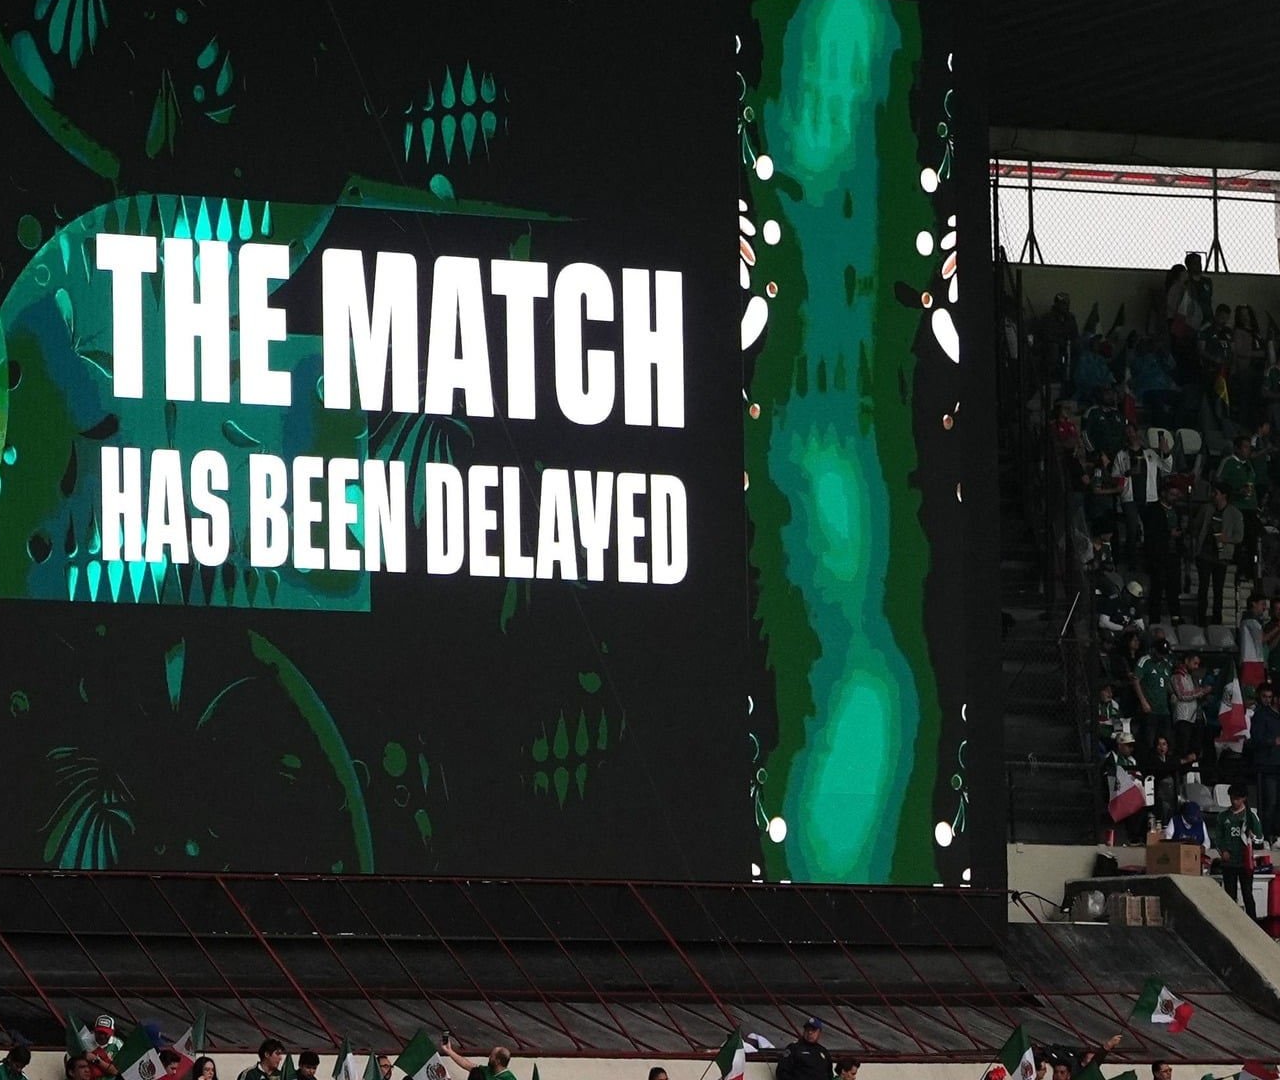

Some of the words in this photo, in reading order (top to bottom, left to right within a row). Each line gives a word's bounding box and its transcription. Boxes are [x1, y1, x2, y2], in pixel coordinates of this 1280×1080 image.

[96, 233, 292, 407] THE
[322, 248, 686, 429] MATCH
[101, 446, 230, 567] HAS
[249, 453, 408, 573] BEEN
[425, 462, 688, 585] DELAYED
